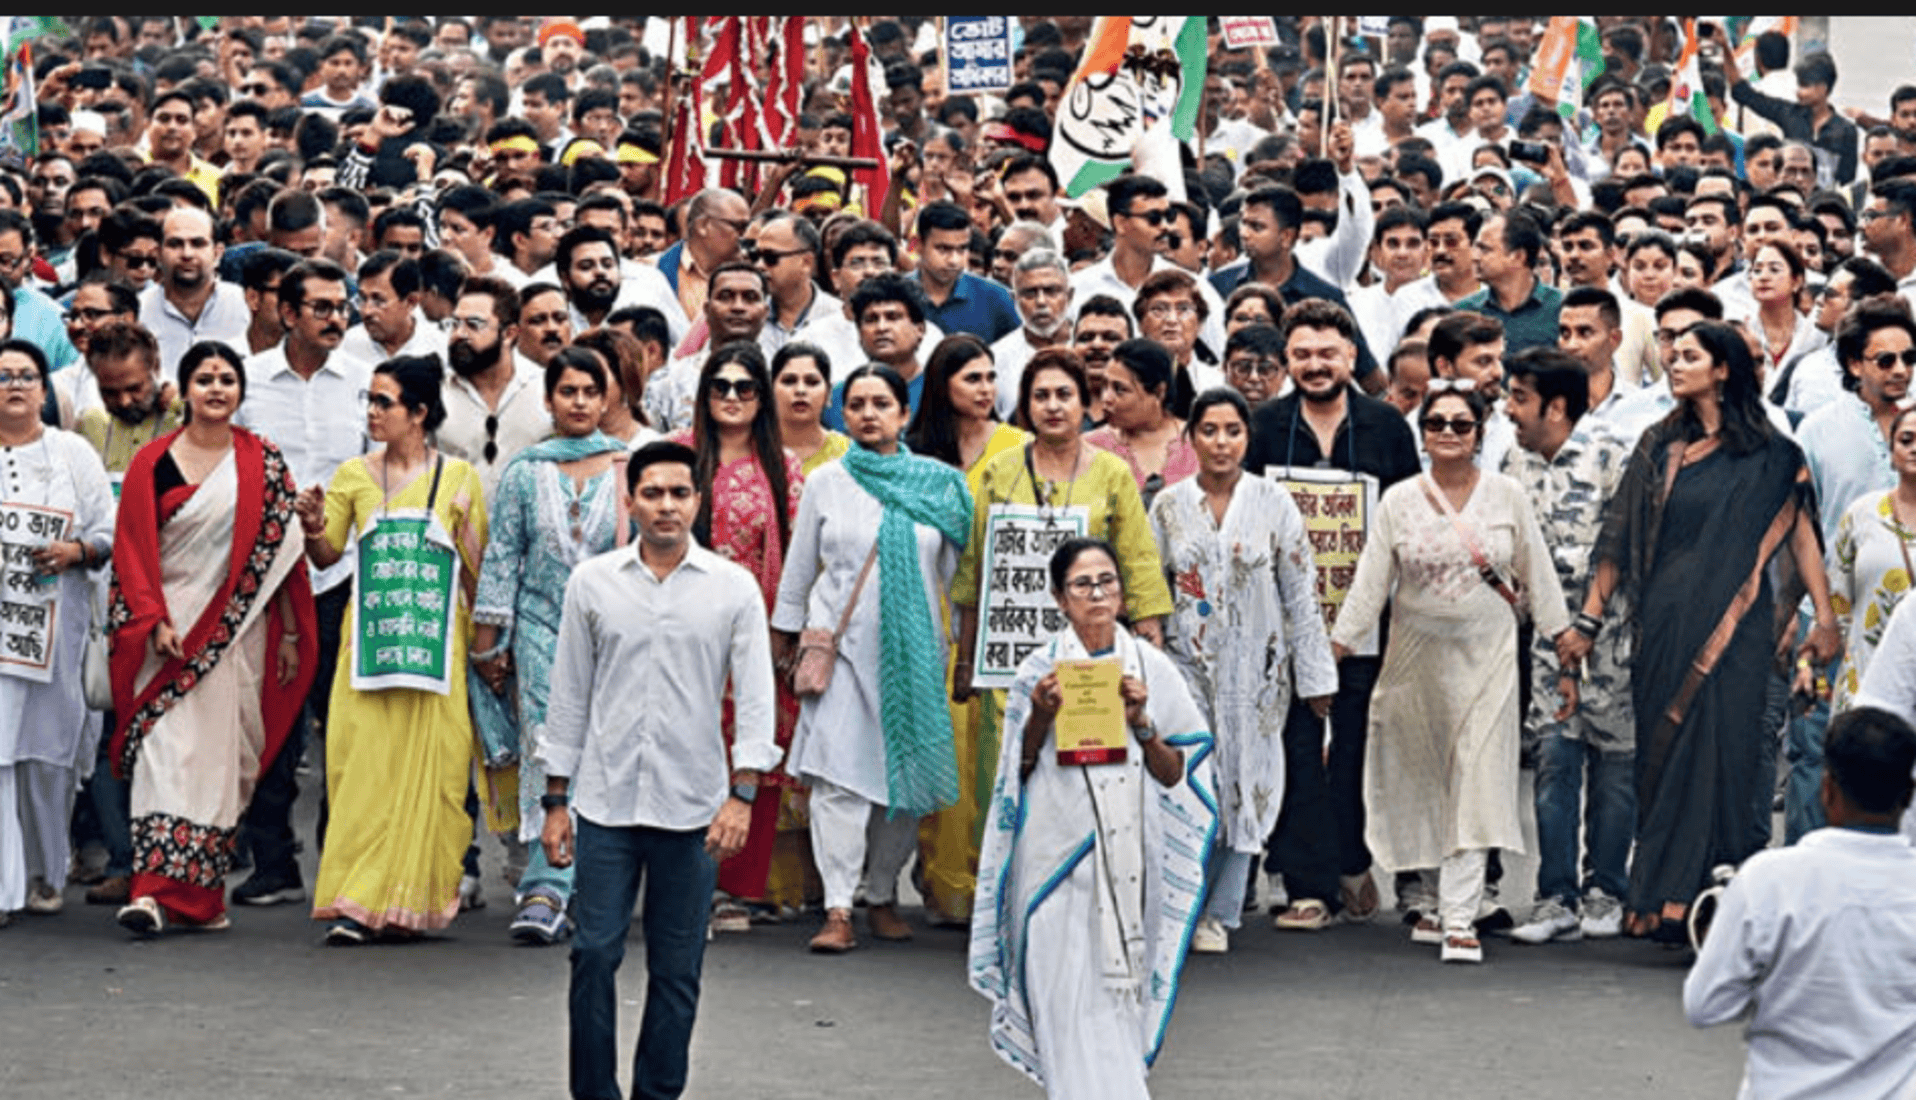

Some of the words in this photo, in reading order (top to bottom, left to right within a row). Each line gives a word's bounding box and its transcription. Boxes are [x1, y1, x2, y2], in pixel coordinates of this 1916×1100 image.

[951, 16, 1005, 39] ভোট
[951, 39, 1005, 59] আমার
[951, 62, 1007, 85] অধিকার
[28, 511, 65, 540] ভাগ
